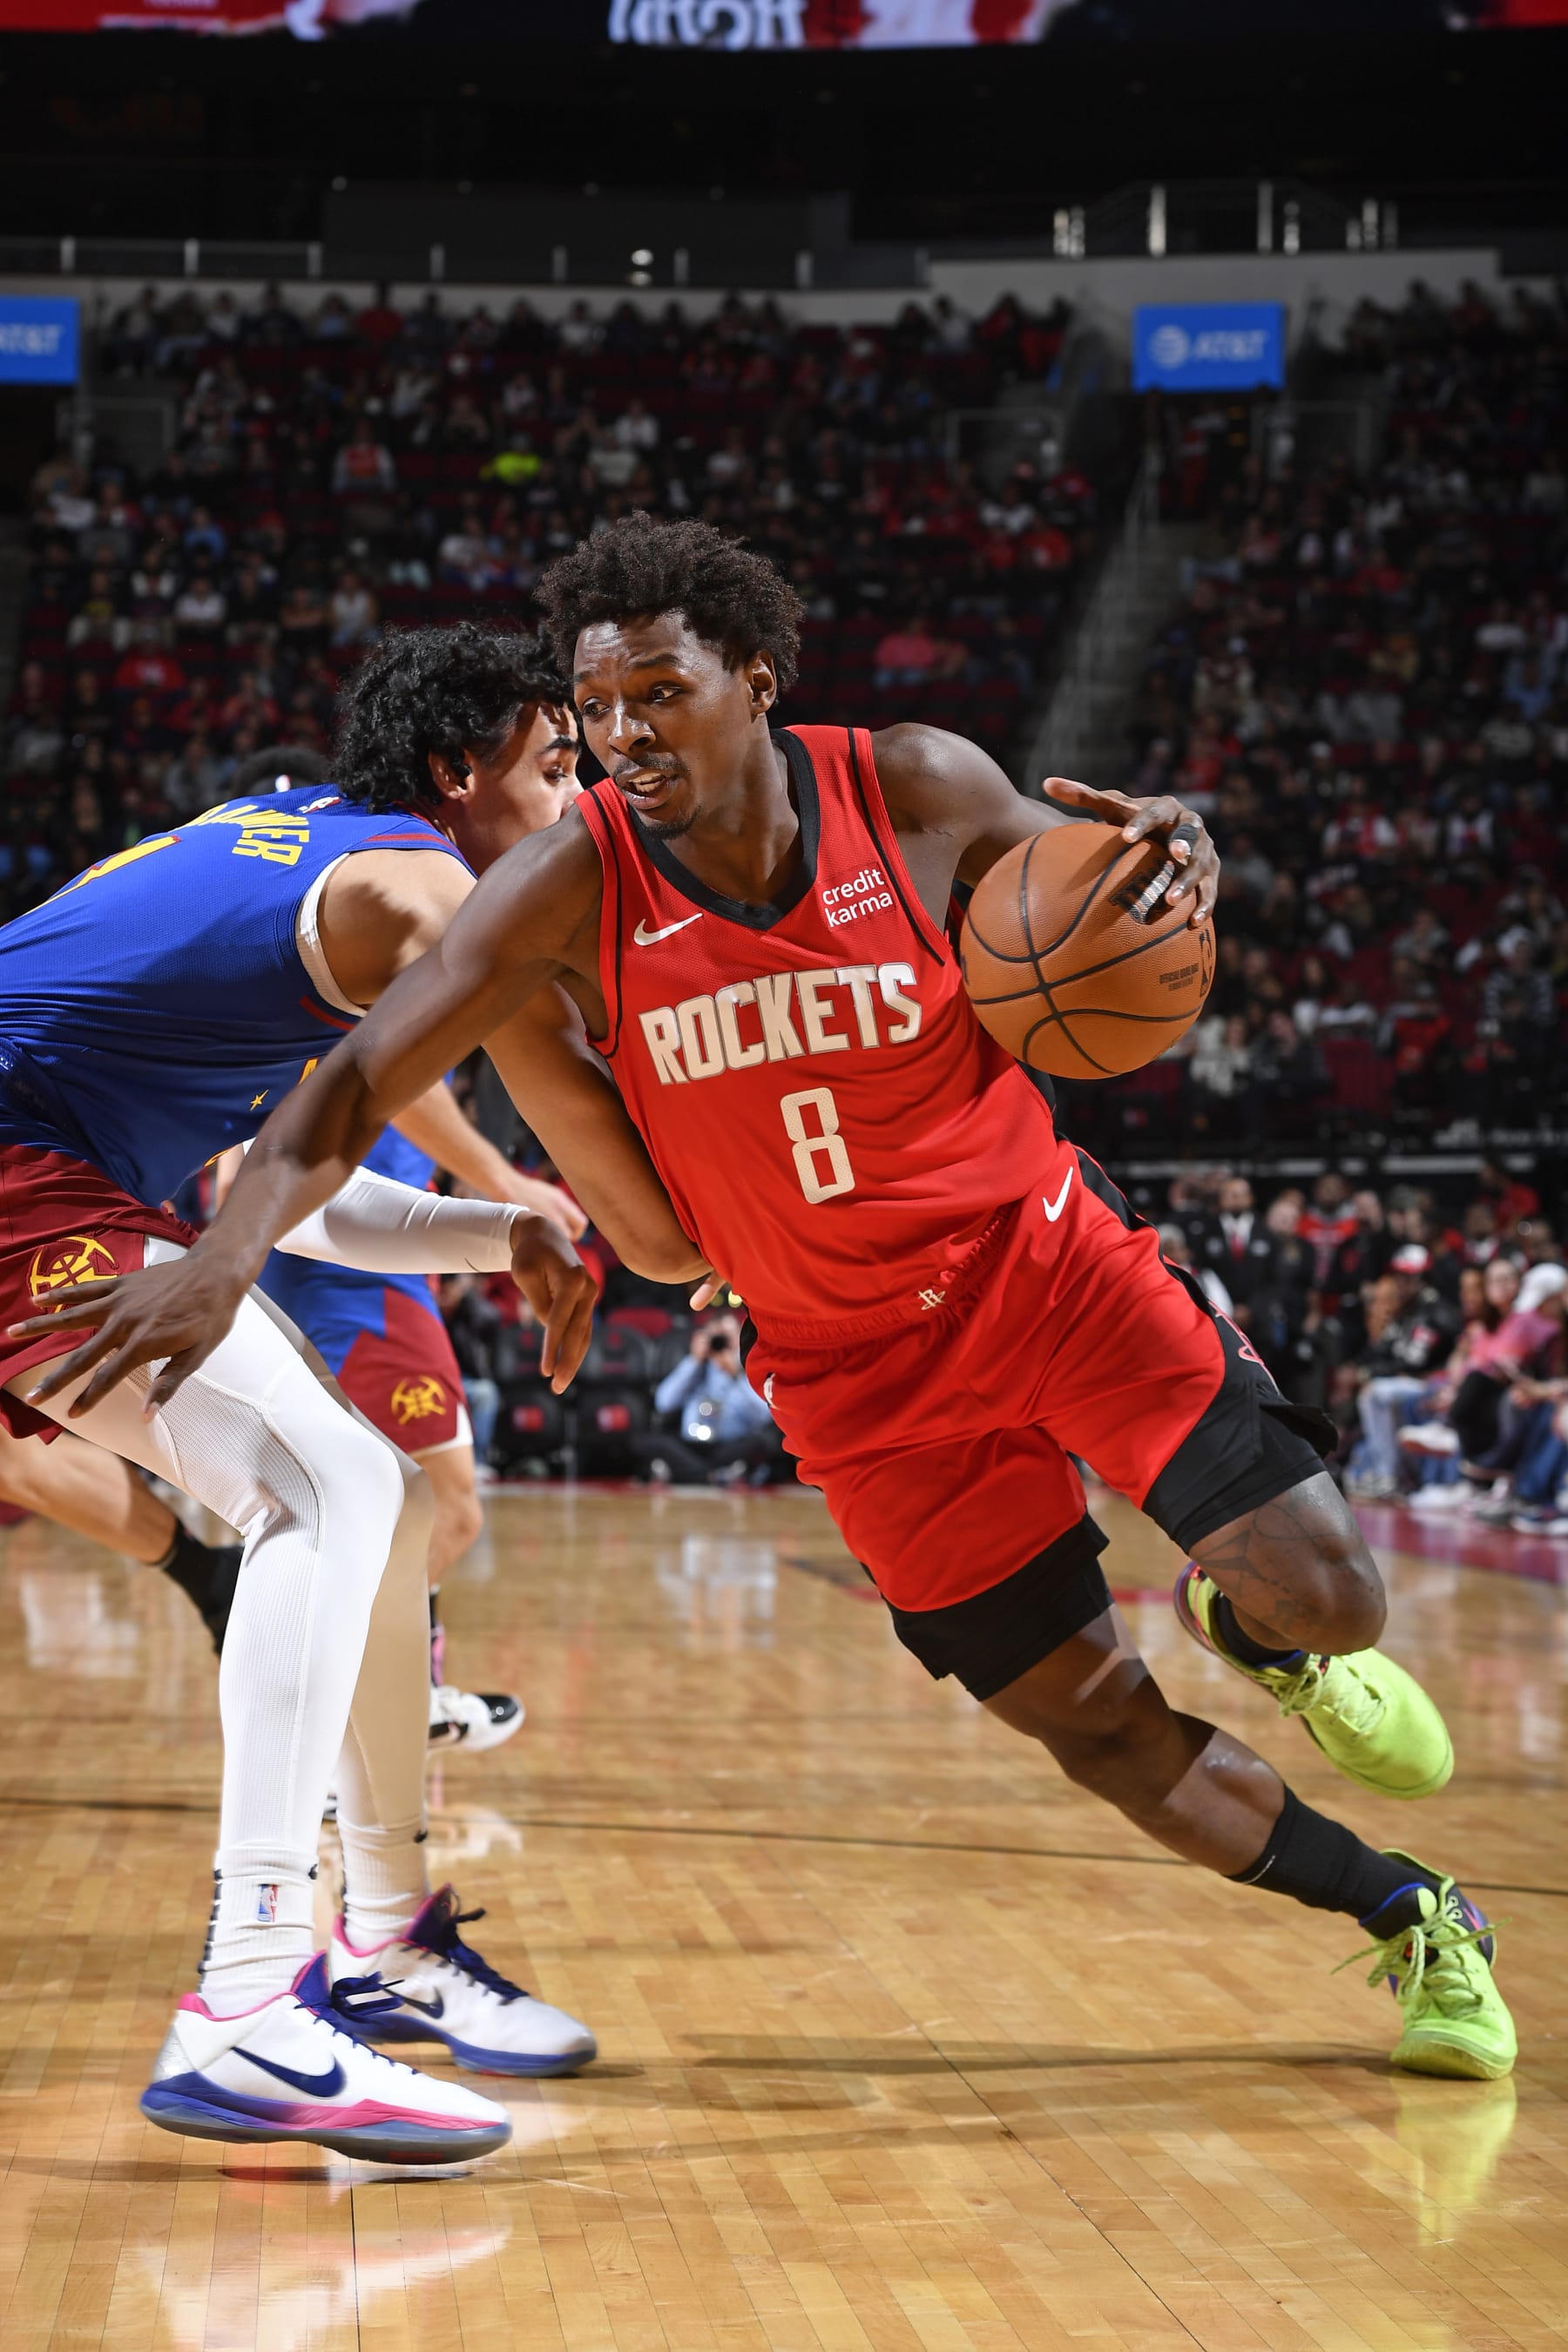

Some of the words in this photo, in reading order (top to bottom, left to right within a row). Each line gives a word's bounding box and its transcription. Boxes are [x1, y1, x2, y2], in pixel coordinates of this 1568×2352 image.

[1194, 329, 1269, 362] AT&T
[822, 869, 884, 905] credit
[825, 892, 893, 928] karma
[639, 962, 922, 1085] ROCKETS
[780, 1087, 855, 1205] 8
